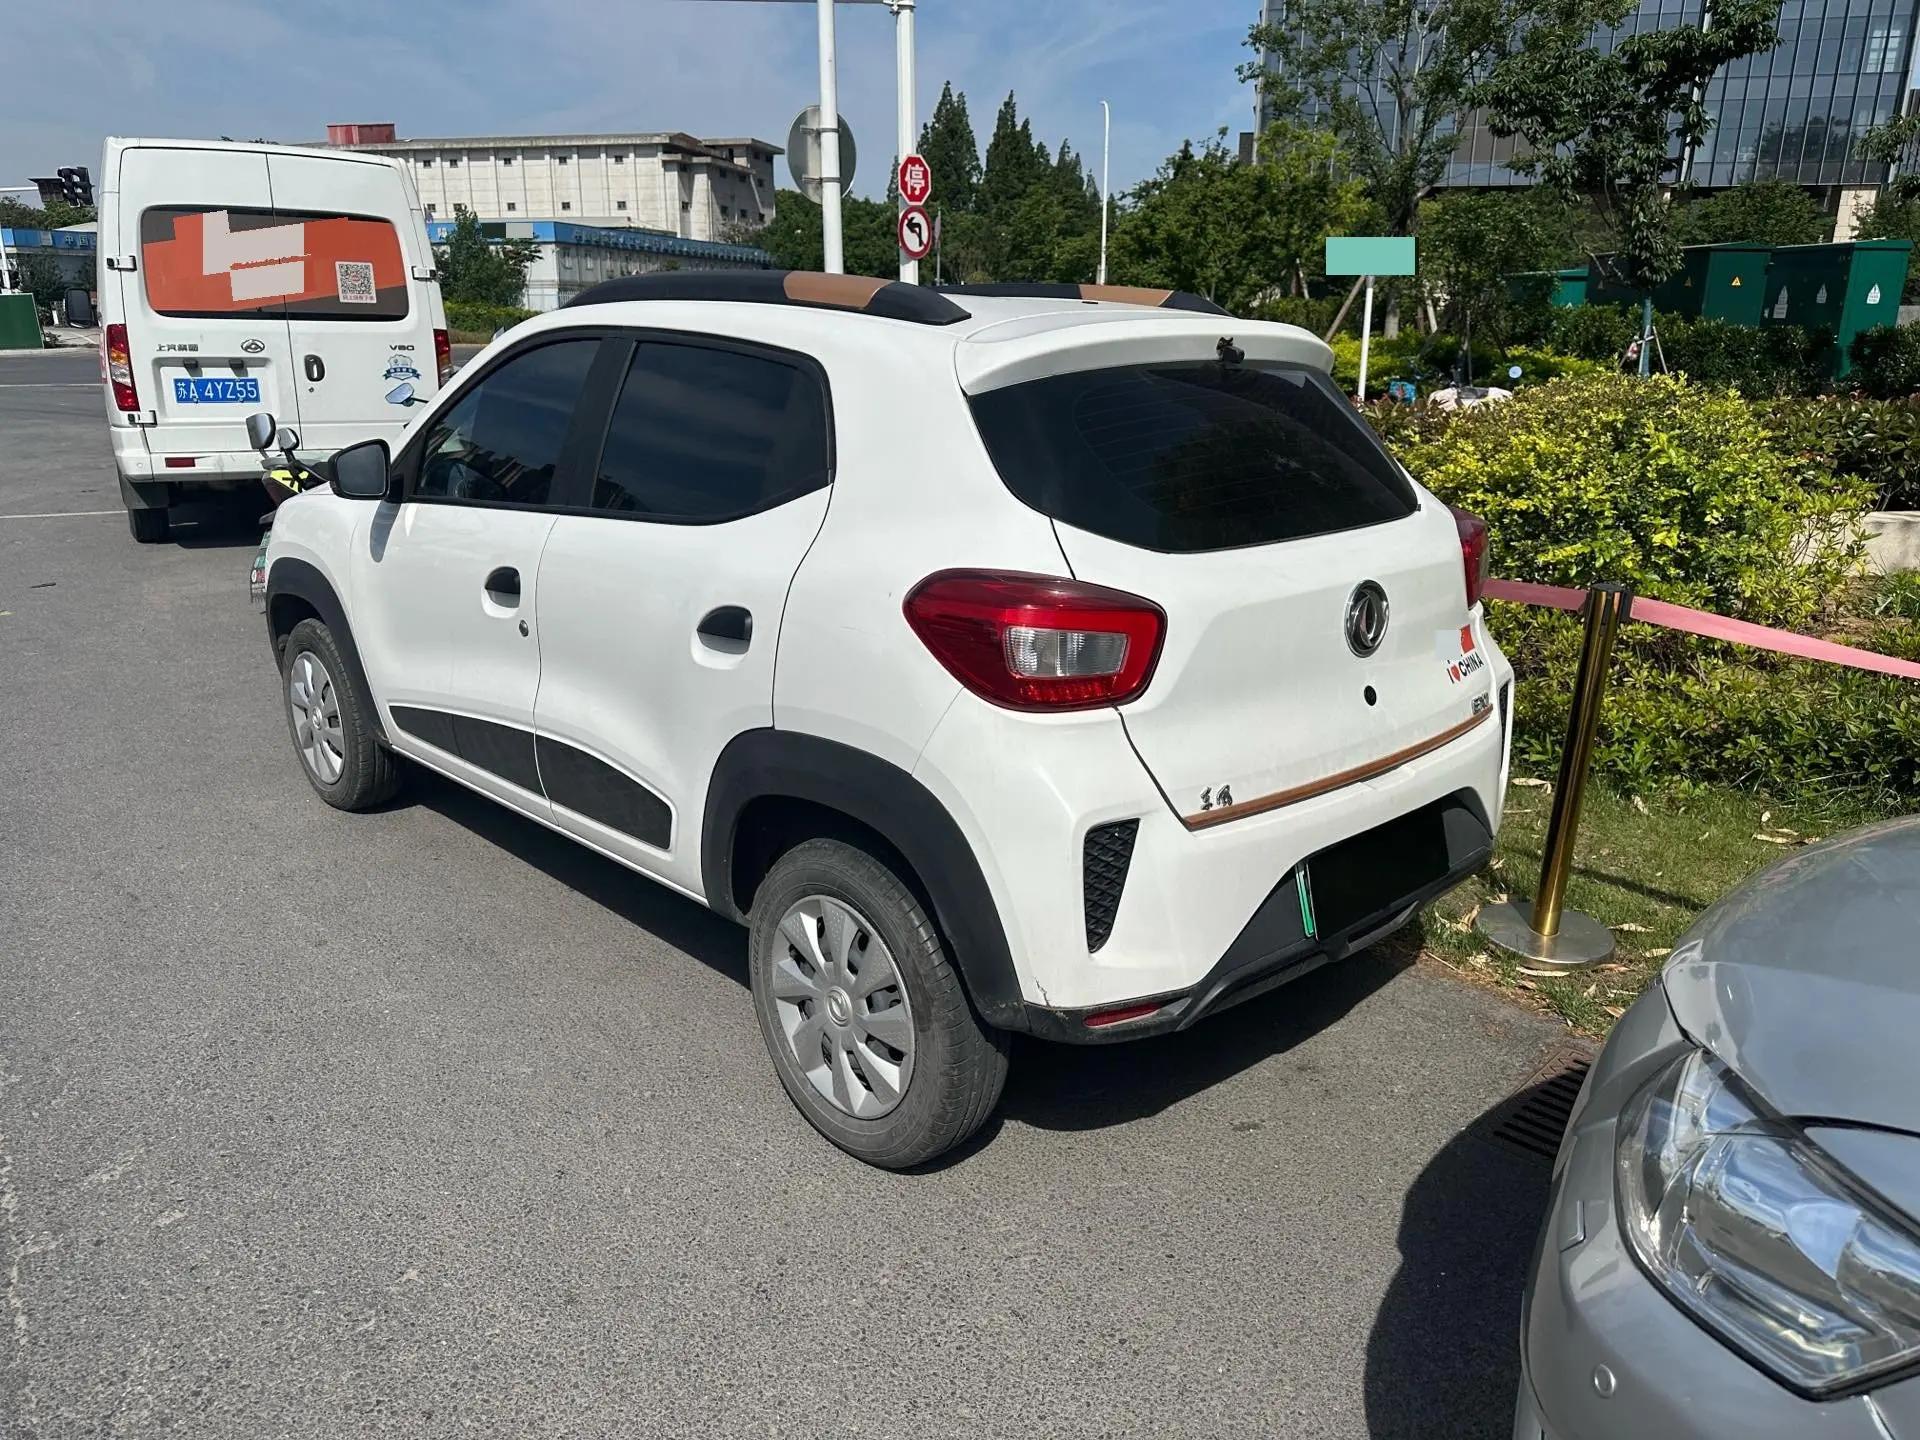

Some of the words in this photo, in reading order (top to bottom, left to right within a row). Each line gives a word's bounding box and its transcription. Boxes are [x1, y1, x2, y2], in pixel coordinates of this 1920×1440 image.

[904, 163, 926, 196] 停
[156, 343, 199, 352] 上汽集团
[1458, 651, 1485, 677] CHINA
